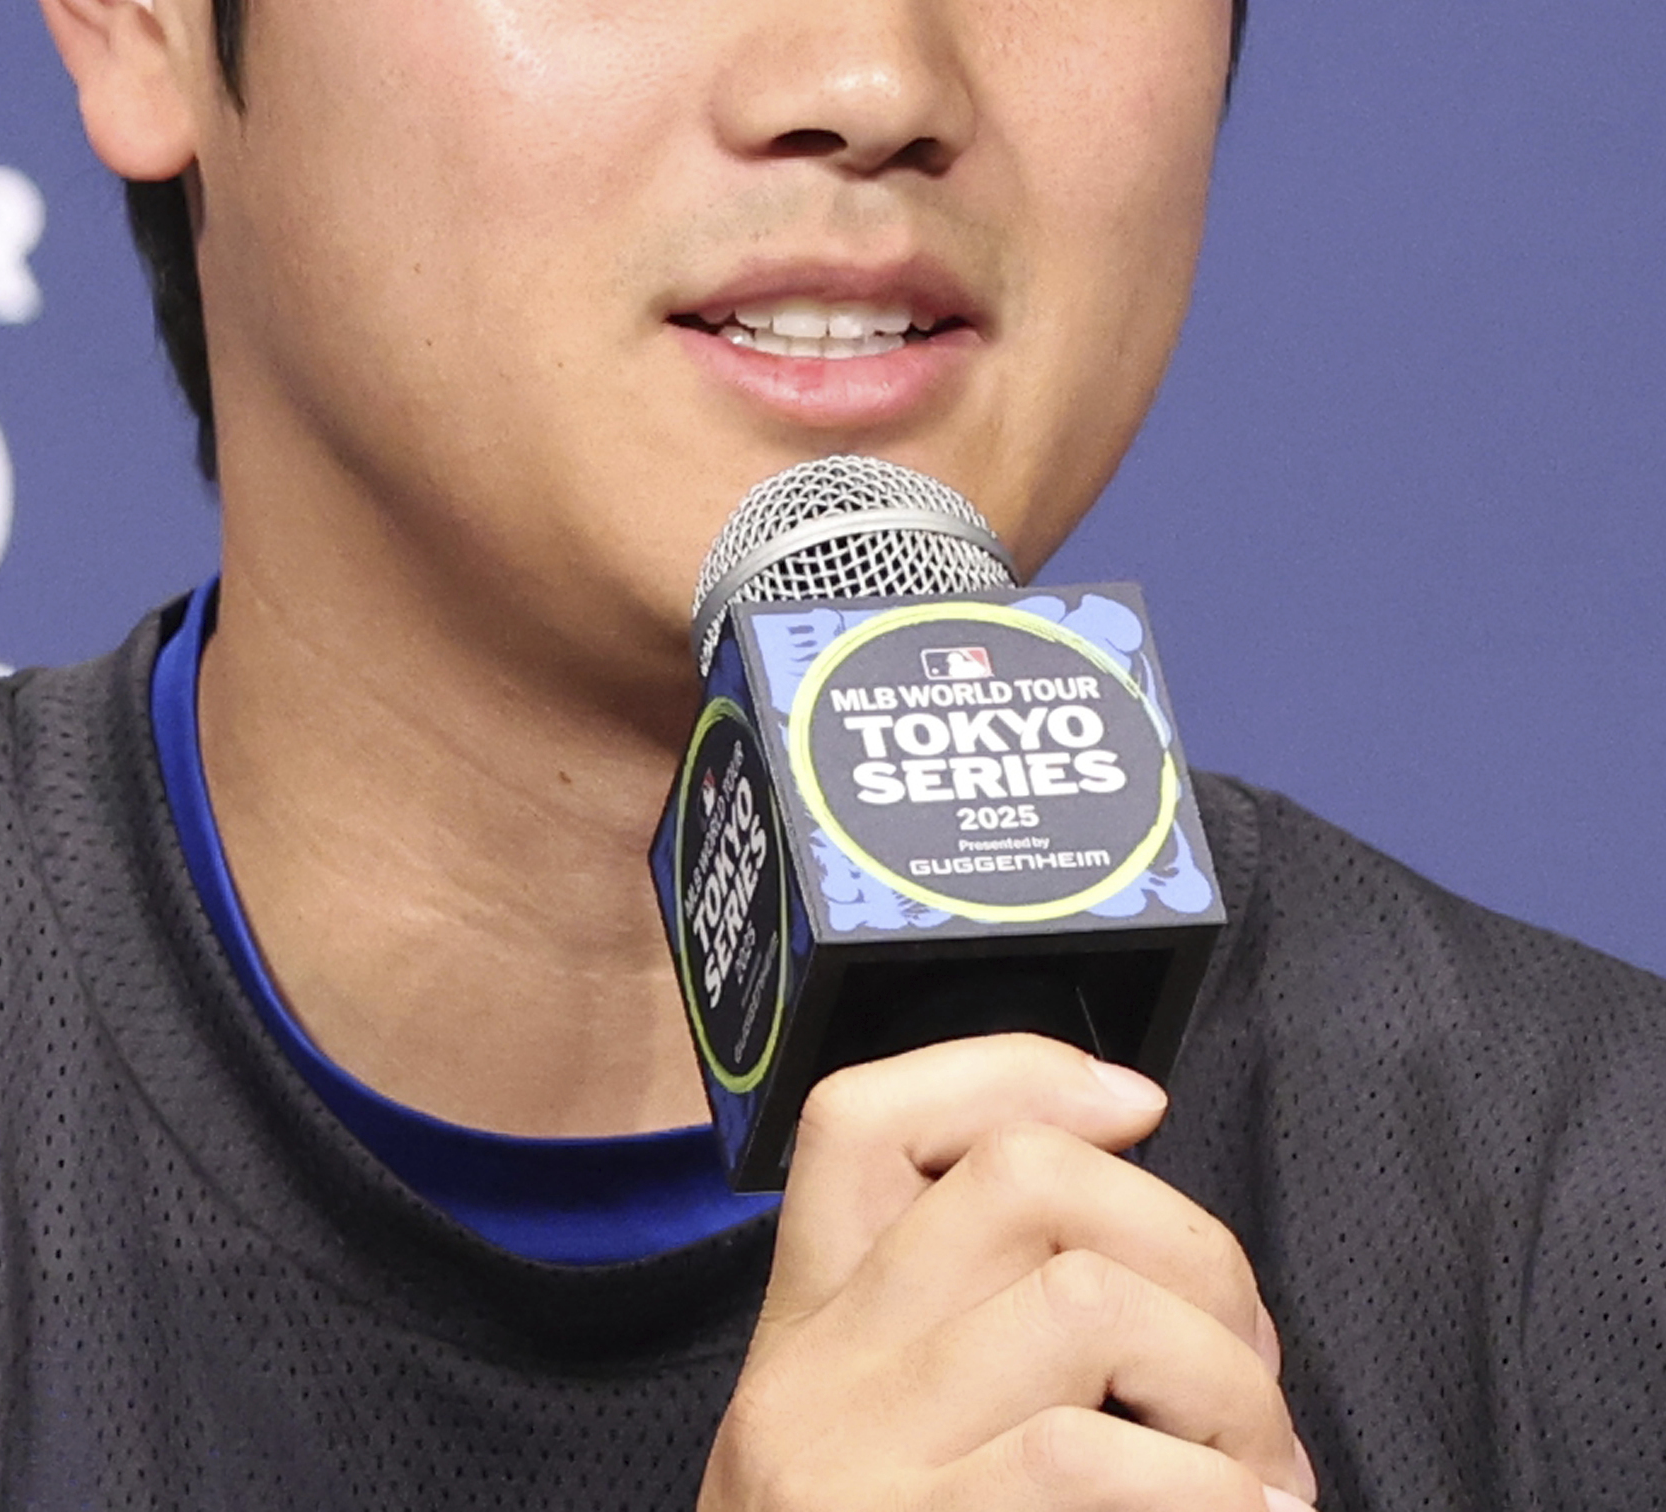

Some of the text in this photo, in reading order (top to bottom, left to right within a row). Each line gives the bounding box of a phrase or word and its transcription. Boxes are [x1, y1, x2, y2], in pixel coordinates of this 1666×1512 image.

[830, 676, 1101, 712] MLB WORLD TOUR
[843, 704, 1105, 758] TOKYO
[852, 749, 1128, 805] SERIES
[956, 804, 1039, 831] 2025
[693, 776, 753, 954] TOKYO
[909, 849, 1111, 876] GUGGENHEIM
[959, 835, 1051, 852] Presented by
[704, 814, 767, 1009] SERIES
